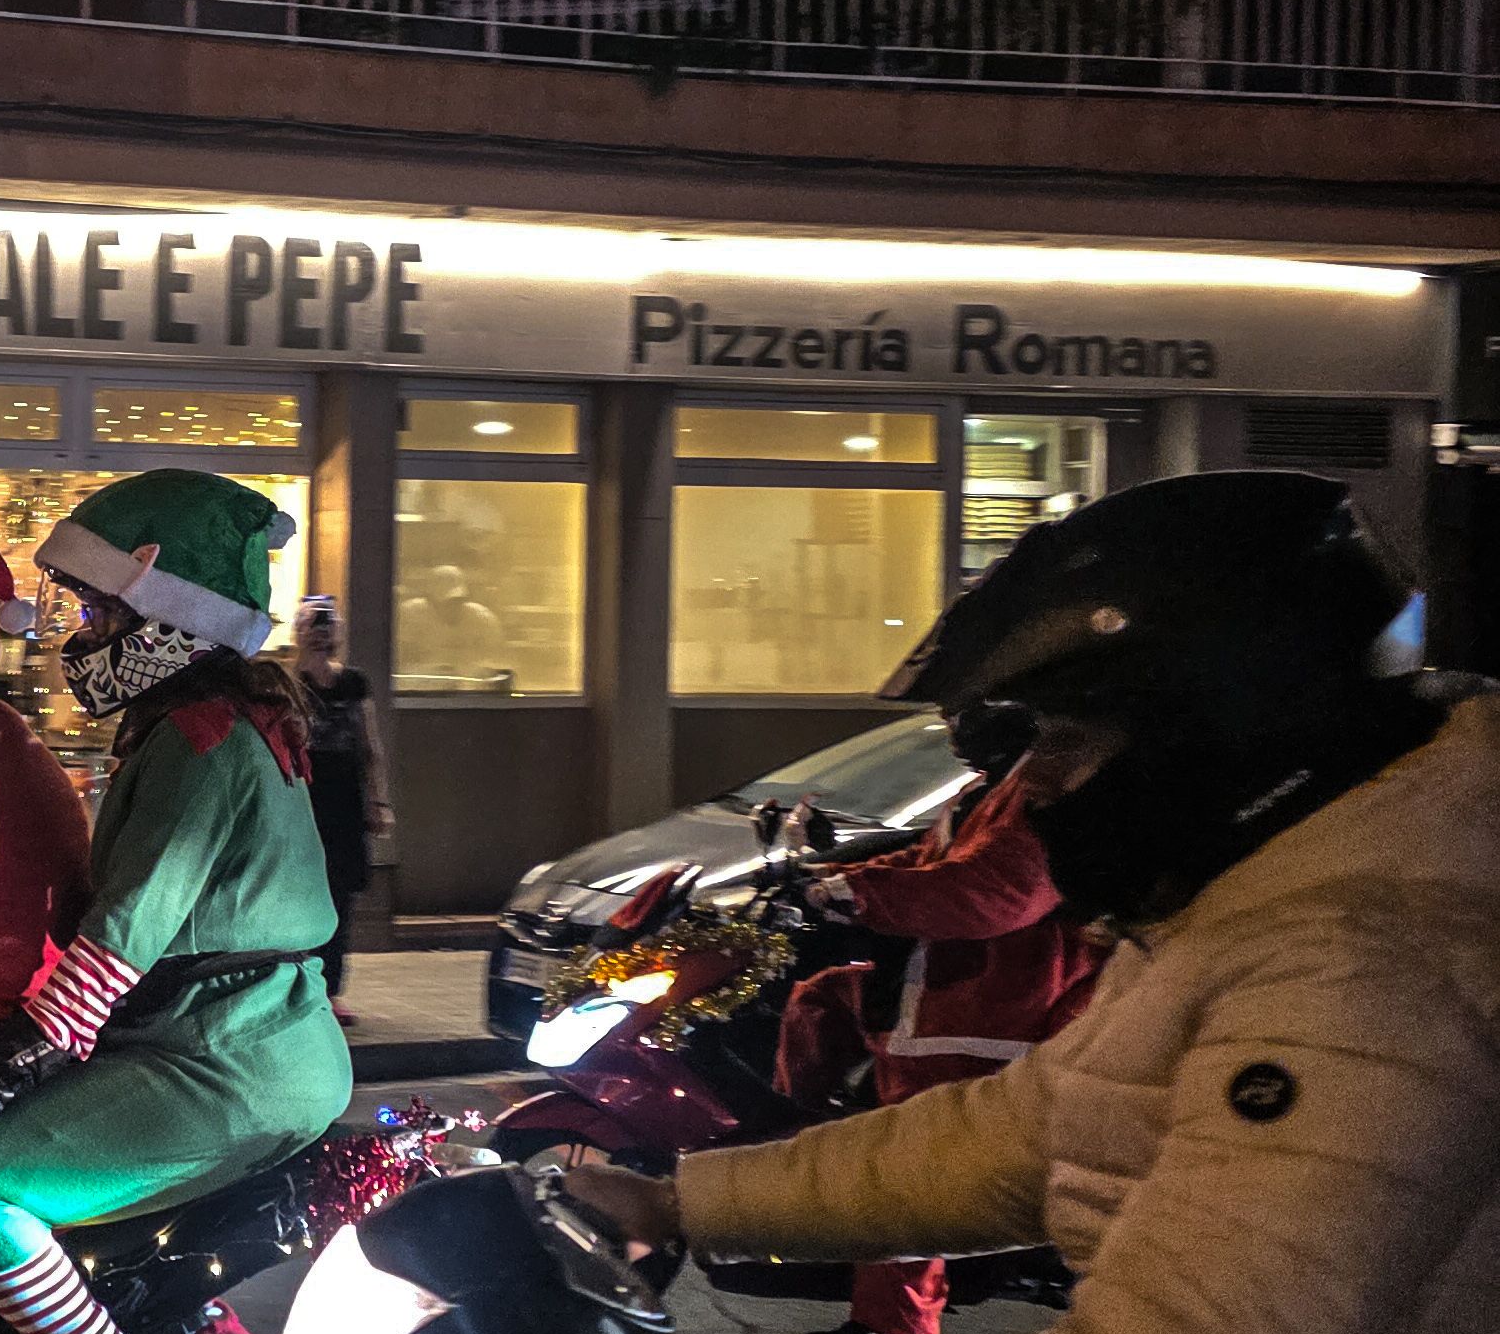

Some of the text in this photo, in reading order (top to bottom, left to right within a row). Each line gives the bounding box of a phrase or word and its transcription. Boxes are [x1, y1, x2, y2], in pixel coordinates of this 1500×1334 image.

[154, 232, 198, 343] E
[227, 234, 425, 354] PEPE
[629, 294, 1219, 379] Pizzería Romana
